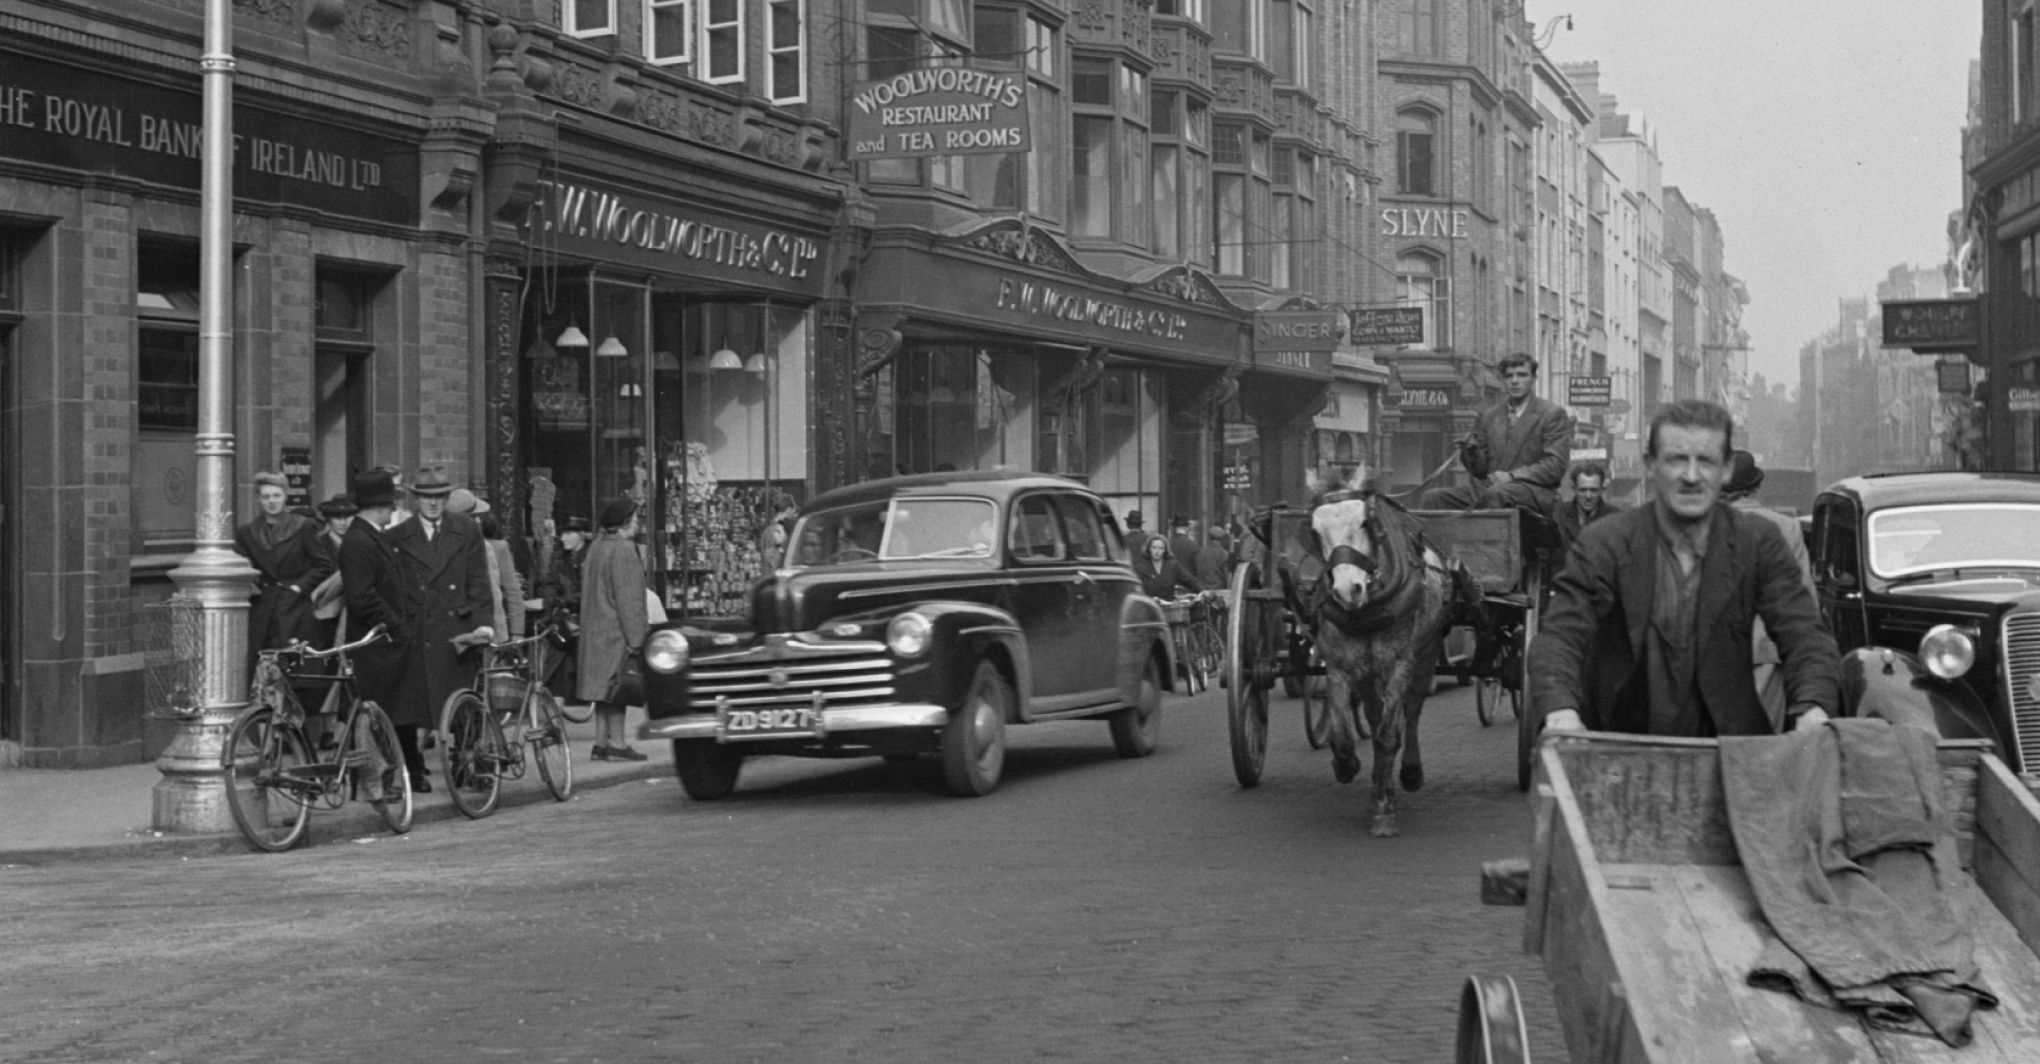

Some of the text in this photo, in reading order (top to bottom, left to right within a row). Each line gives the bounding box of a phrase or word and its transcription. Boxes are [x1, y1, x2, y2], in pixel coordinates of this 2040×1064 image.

[854, 69, 1022, 114] WOOLWORTH'S
[882, 103, 993, 125] RESTAURANT
[0, 87, 34, 128] HE
[45, 95, 131, 146] ROYAL
[140, 114, 203, 159] BANK
[251, 137, 345, 187] IRELAND
[856, 128, 1021, 153] and TEA ROOMS
[591, 190, 748, 268] WOOLWORTH
[746, 239, 762, 268] &
[1382, 208, 1468, 237] SLYNE
[1042, 287, 1132, 331] WOOLWORTH
[1134, 310, 1145, 331] &
[1259, 319, 1331, 341] SINGER
